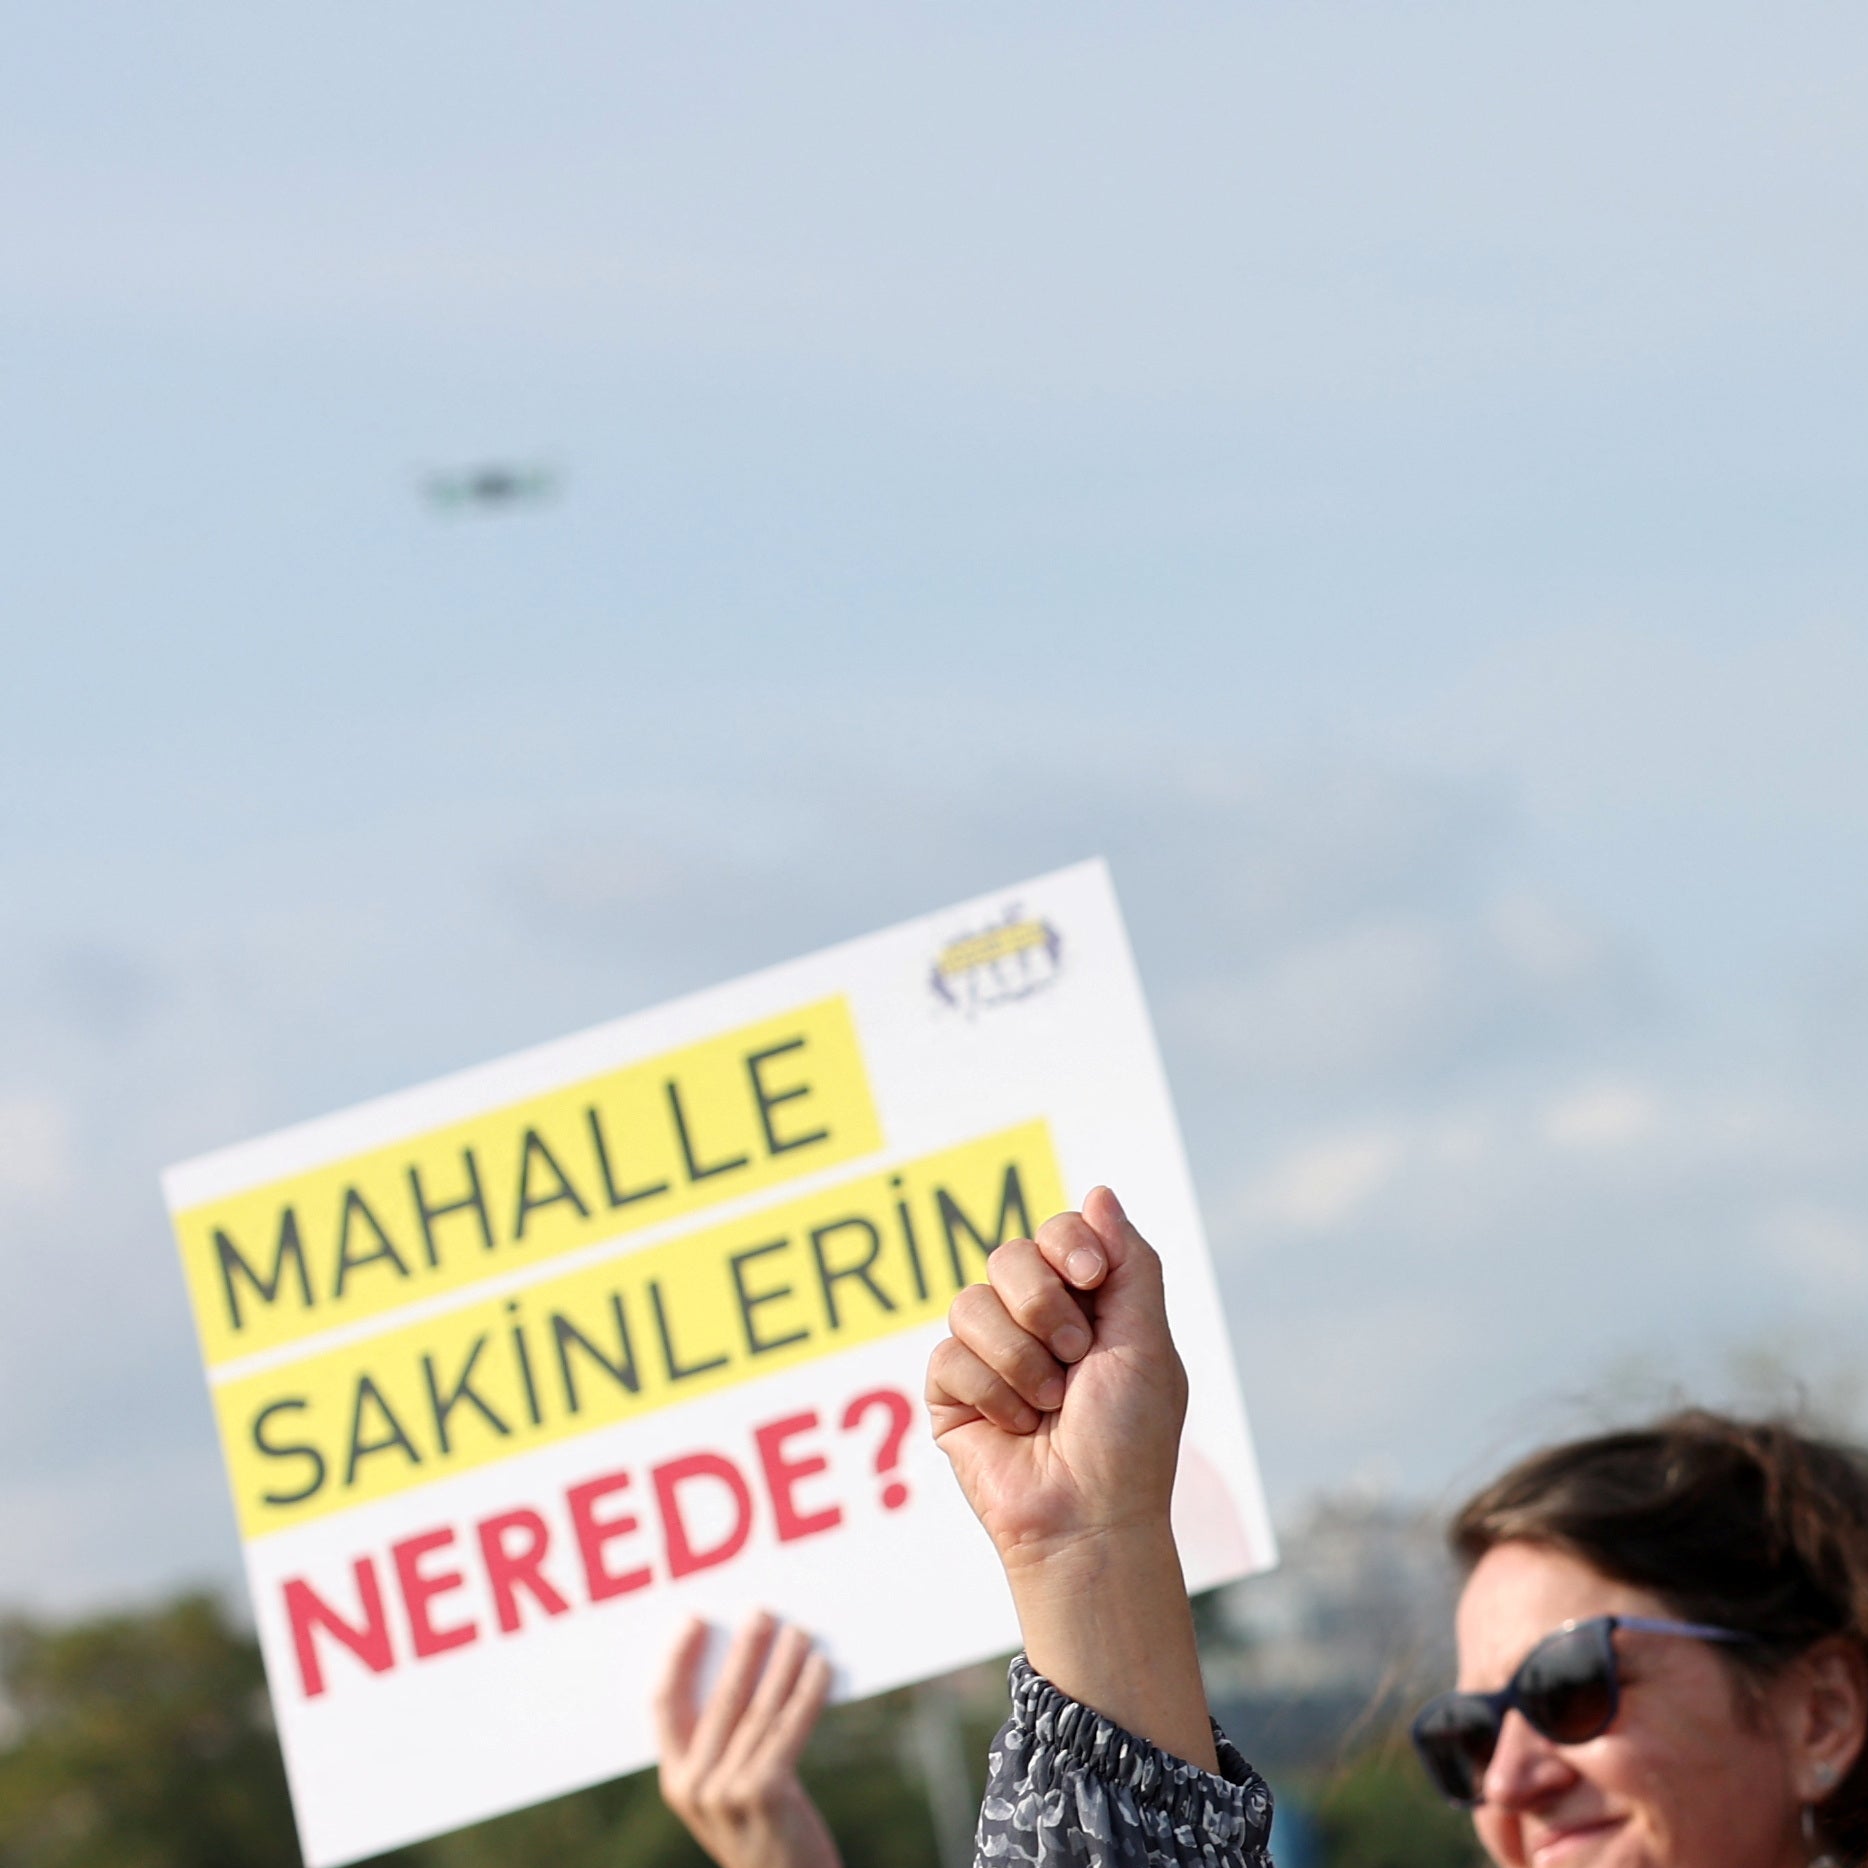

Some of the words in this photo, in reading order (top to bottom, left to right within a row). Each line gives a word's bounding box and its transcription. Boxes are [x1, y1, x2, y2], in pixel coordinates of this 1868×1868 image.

[210, 1035, 831, 1332] MAHALLE
[250, 1161, 1037, 1508] SAKİNLERİM
[278, 1386, 915, 1698] NEREDE?
